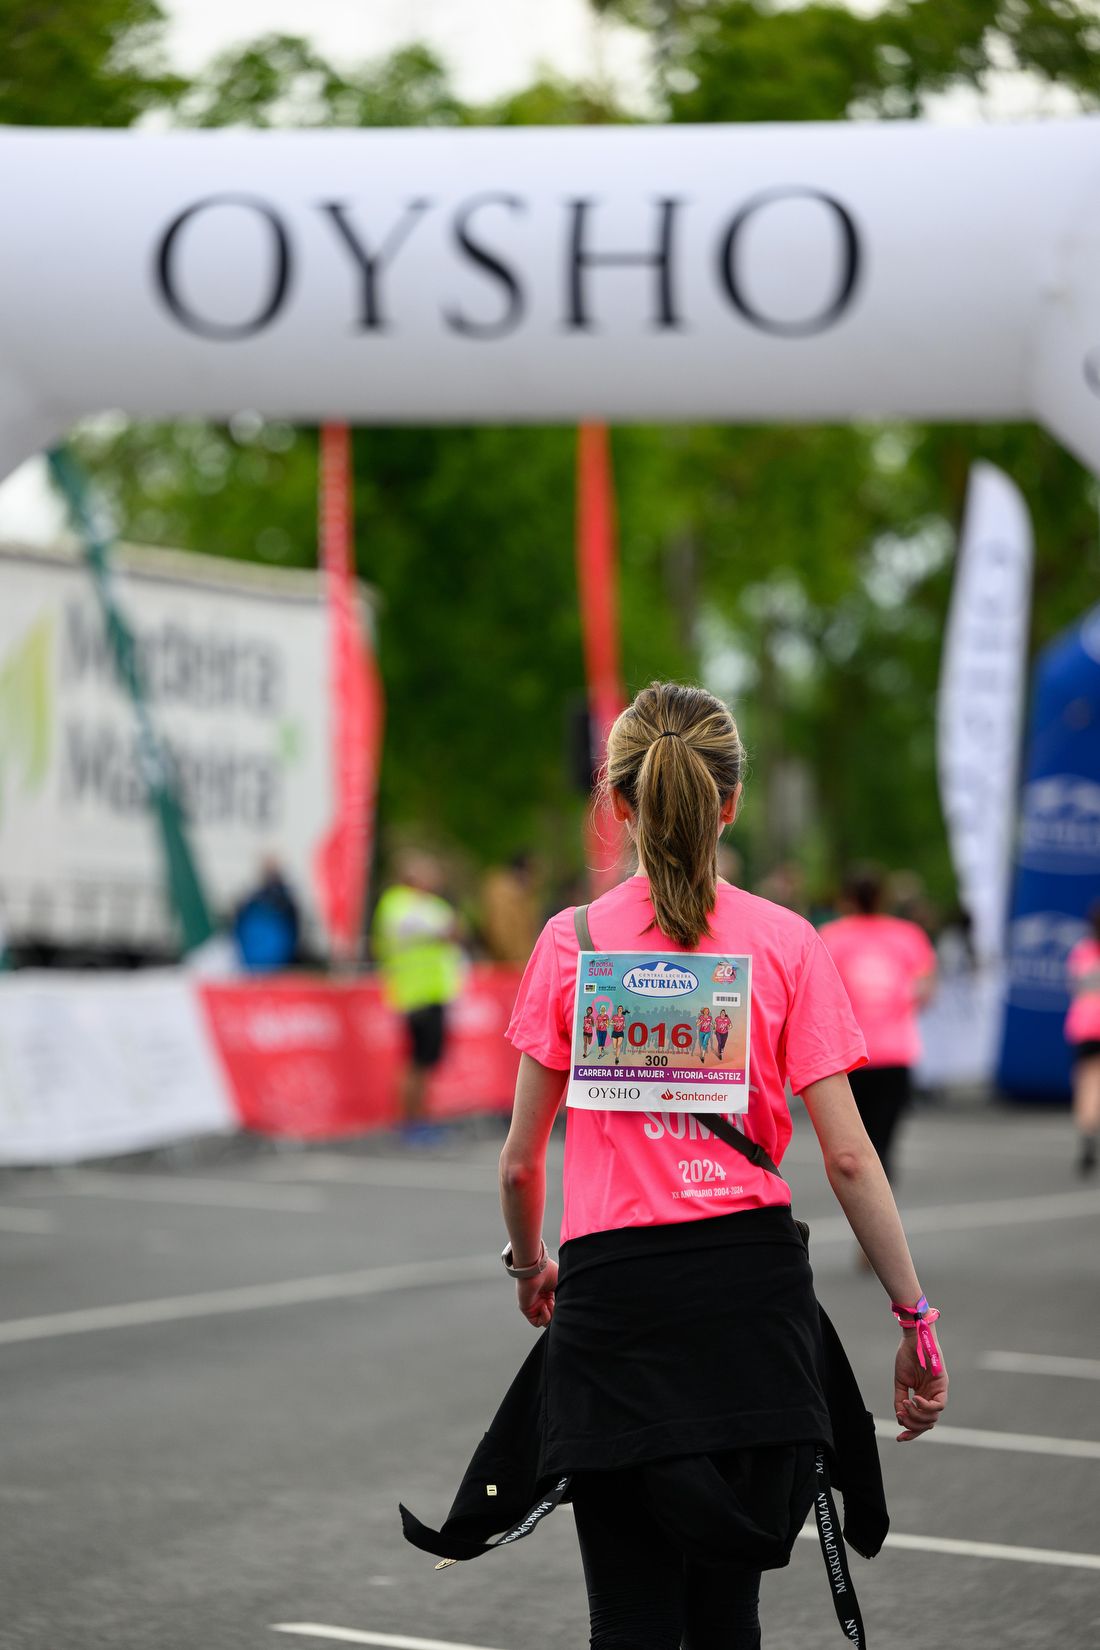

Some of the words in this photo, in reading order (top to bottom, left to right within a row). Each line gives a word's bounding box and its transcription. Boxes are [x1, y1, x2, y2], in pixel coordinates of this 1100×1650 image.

[153, 184, 867, 342] OYSHO
[588, 967, 613, 977] SUMA
[627, 974, 693, 990] ASTURIANA
[627, 1022, 693, 1049] 016
[645, 1055, 668, 1067] 300
[578, 1068, 612, 1078] CARRERA
[613, 1069, 624, 1078] DE
[625, 1069, 636, 1078] LA
[637, 1069, 665, 1079] MUJER
[672, 1071, 741, 1081] VITORIA-GASTEIZ
[588, 1087, 641, 1100] OYSHO
[675, 1091, 728, 1102] Santander
[678, 1159, 727, 1183] 2024
[817, 1492, 847, 1595] MARKUPWOMAN
